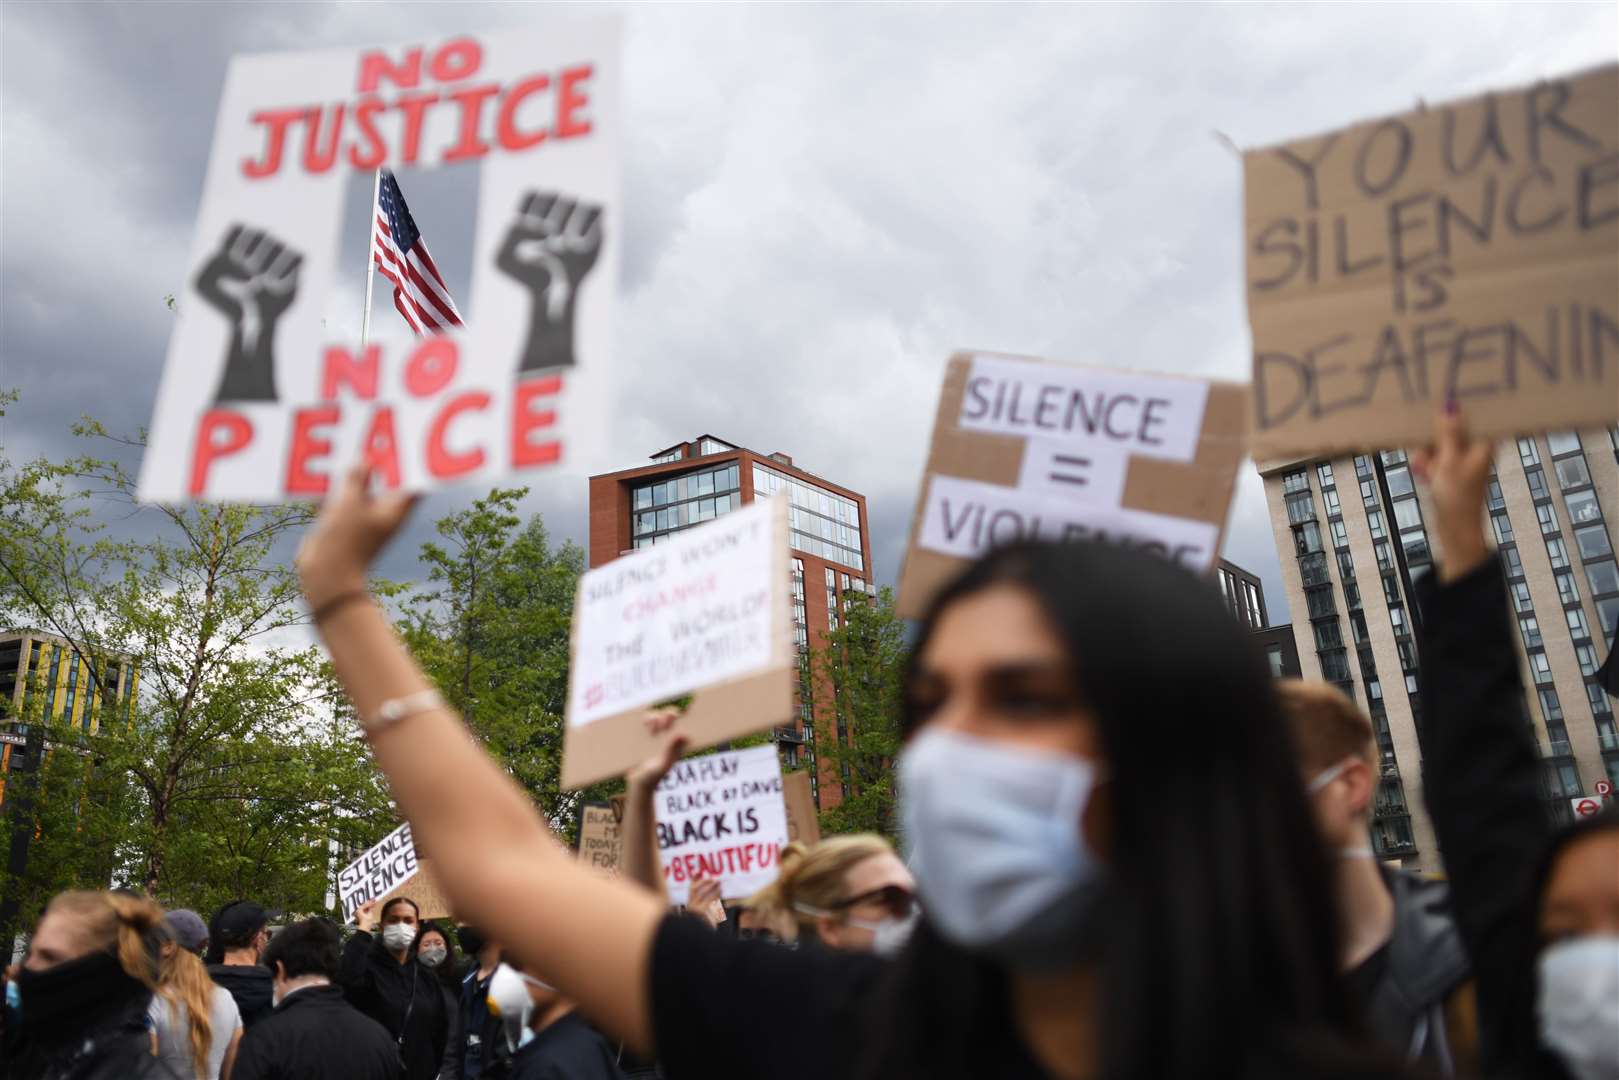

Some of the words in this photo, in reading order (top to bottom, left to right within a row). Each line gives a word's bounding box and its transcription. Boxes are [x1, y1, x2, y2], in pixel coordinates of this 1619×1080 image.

[358, 37, 483, 93] NO
[242, 65, 593, 179] JUSTICE
[1280, 82, 1602, 211] YOUR
[1252, 156, 1619, 291] SILENCE
[1394, 264, 1455, 314] IS
[320, 336, 459, 401] NO
[189, 376, 563, 497] PEACE
[964, 376, 1171, 446] SILENCE
[940, 498, 1206, 568] VIOL
[605, 632, 644, 664] THE
[666, 791, 714, 814] BLACK
[741, 778, 783, 799] DAVE
[699, 758, 739, 781] PLAY
[340, 823, 412, 891] SILENCE
[656, 812, 732, 849] BLACK
[737, 807, 759, 834] IS
[341, 848, 417, 920] VIOLENCE
